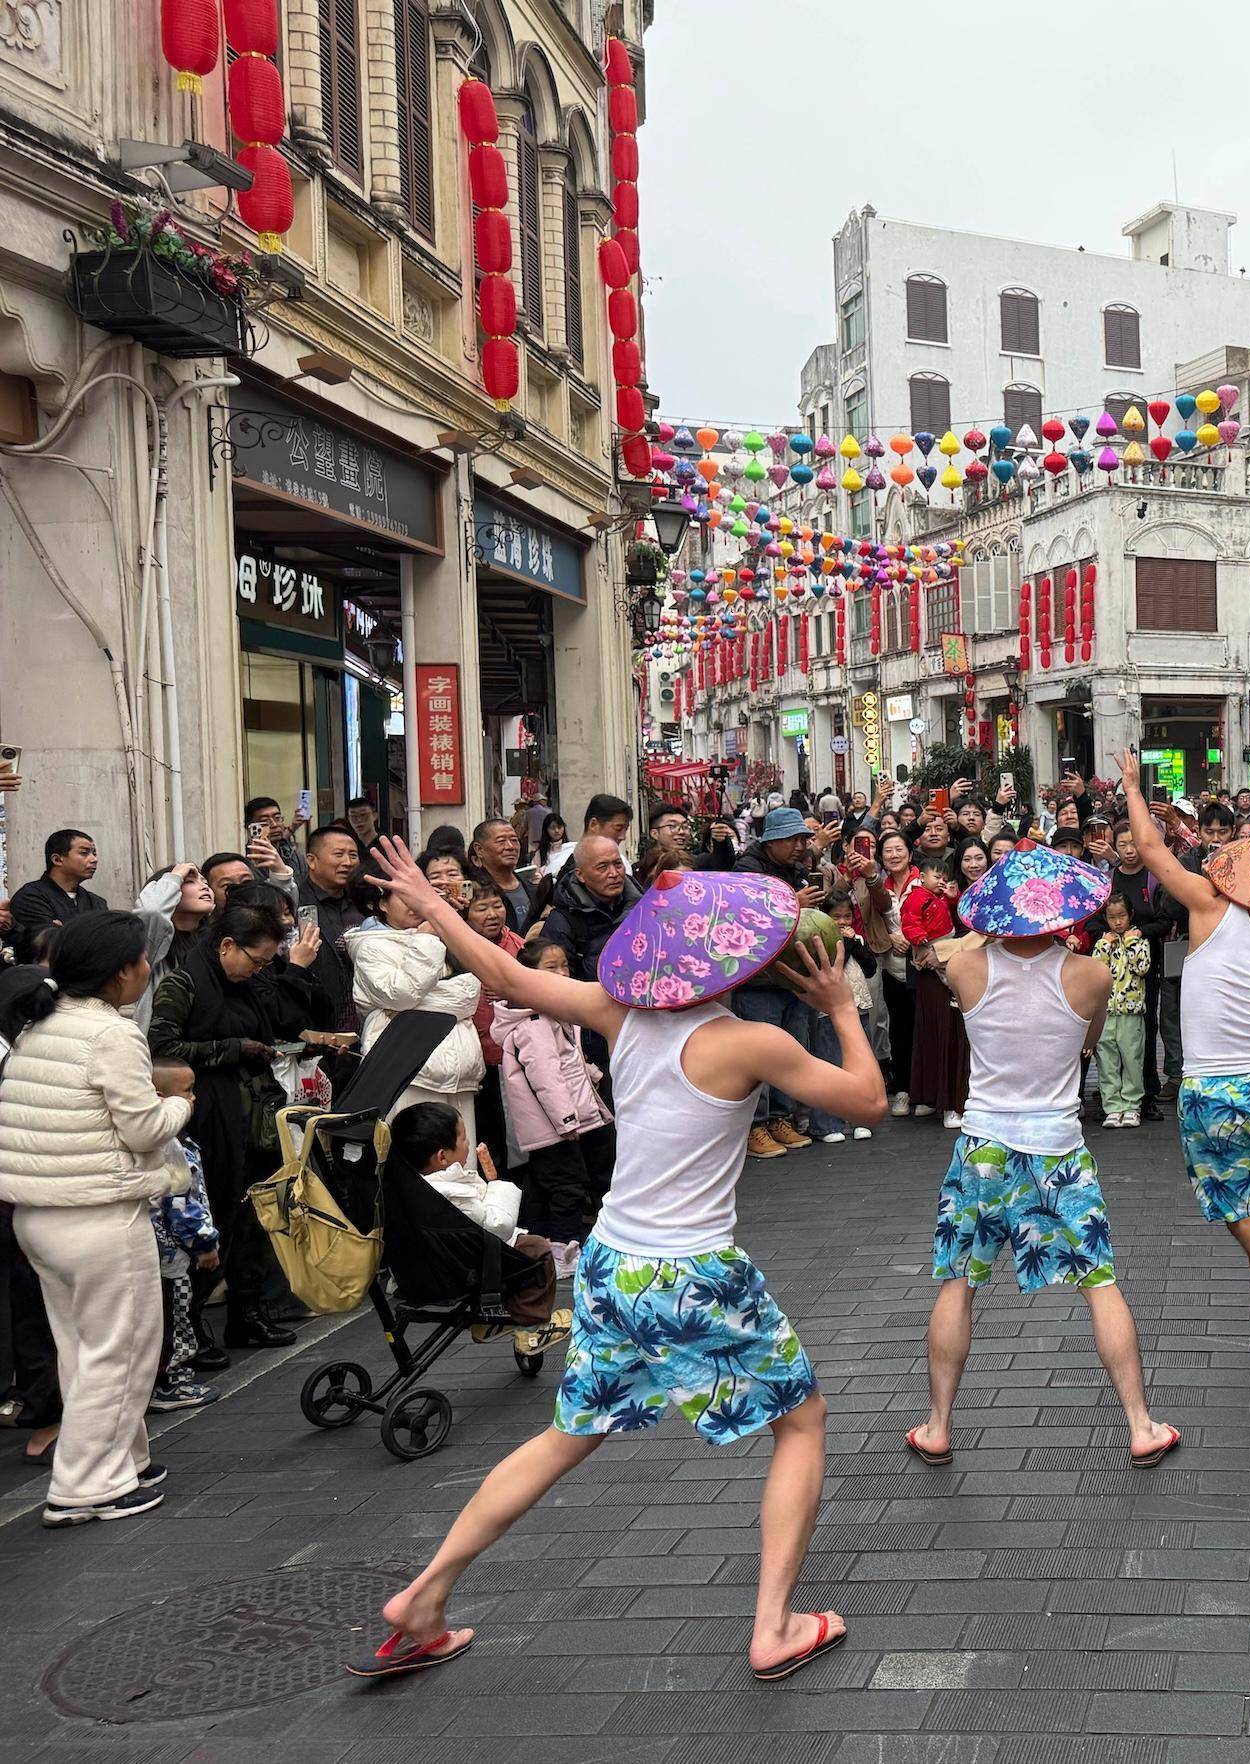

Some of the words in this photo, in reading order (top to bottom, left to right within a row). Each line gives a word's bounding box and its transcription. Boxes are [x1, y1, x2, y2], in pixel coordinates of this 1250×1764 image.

[428, 676, 454, 790] 字画装裱销售
